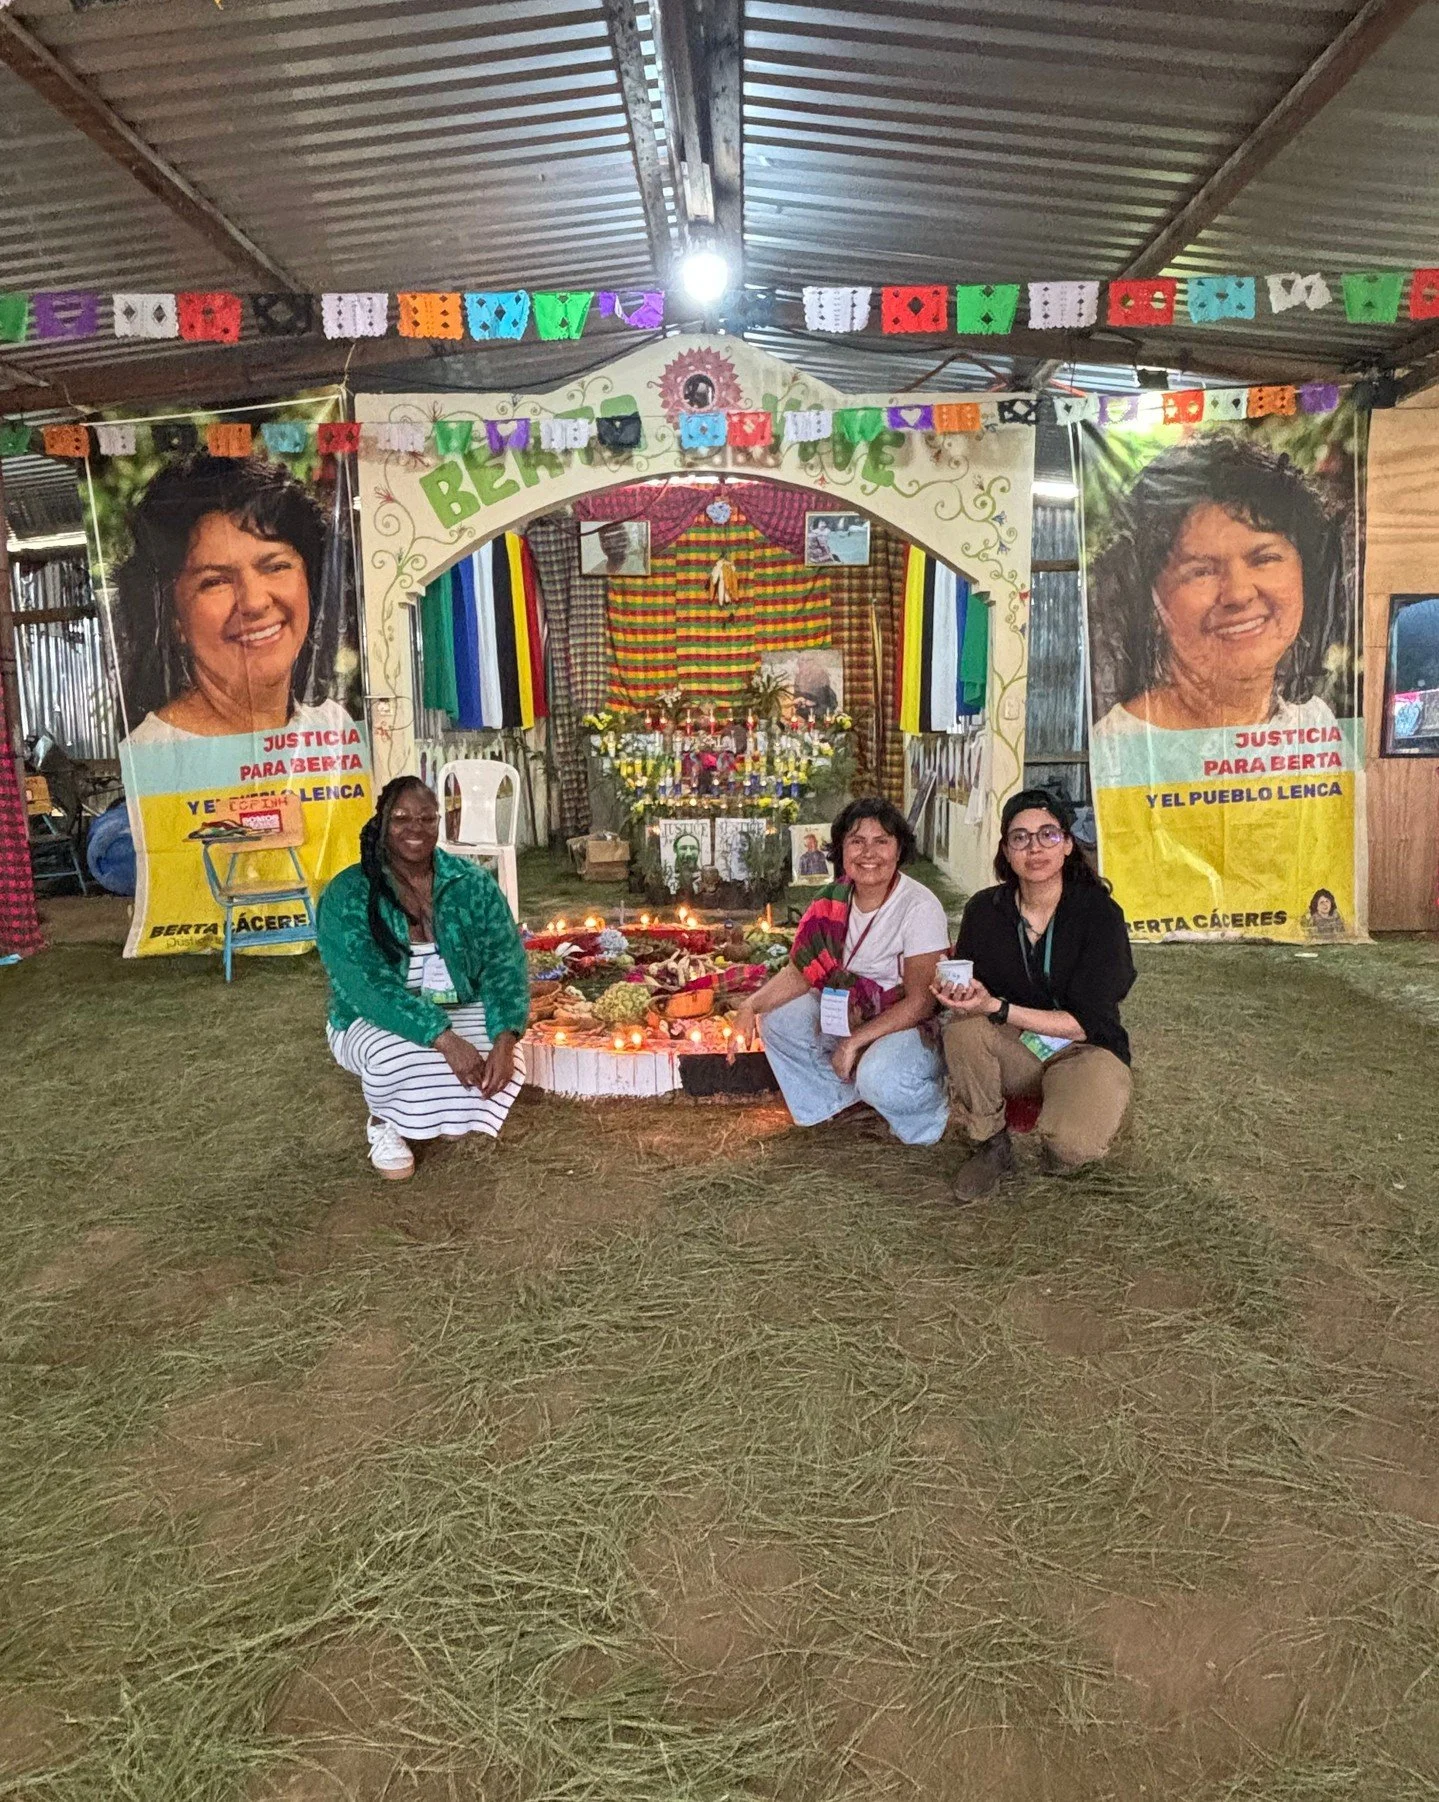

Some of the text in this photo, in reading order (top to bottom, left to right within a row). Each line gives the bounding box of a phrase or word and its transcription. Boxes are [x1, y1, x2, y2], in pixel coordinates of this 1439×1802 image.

[263, 728, 361, 752] JUSTICIA
[1235, 726, 1342, 748] JUSTICIA
[240, 754, 363, 781] PARA BERTA
[1204, 752, 1342, 776] PARA BERTA
[188, 801, 199, 815] Y
[204, 798, 221, 813] E
[300, 784, 365, 802] LENCA
[1146, 782, 1342, 808] Y EL PUEBLO LENCA
[149, 923, 218, 938] BERTA
[1193, 908, 1288, 929] CÁCERES
